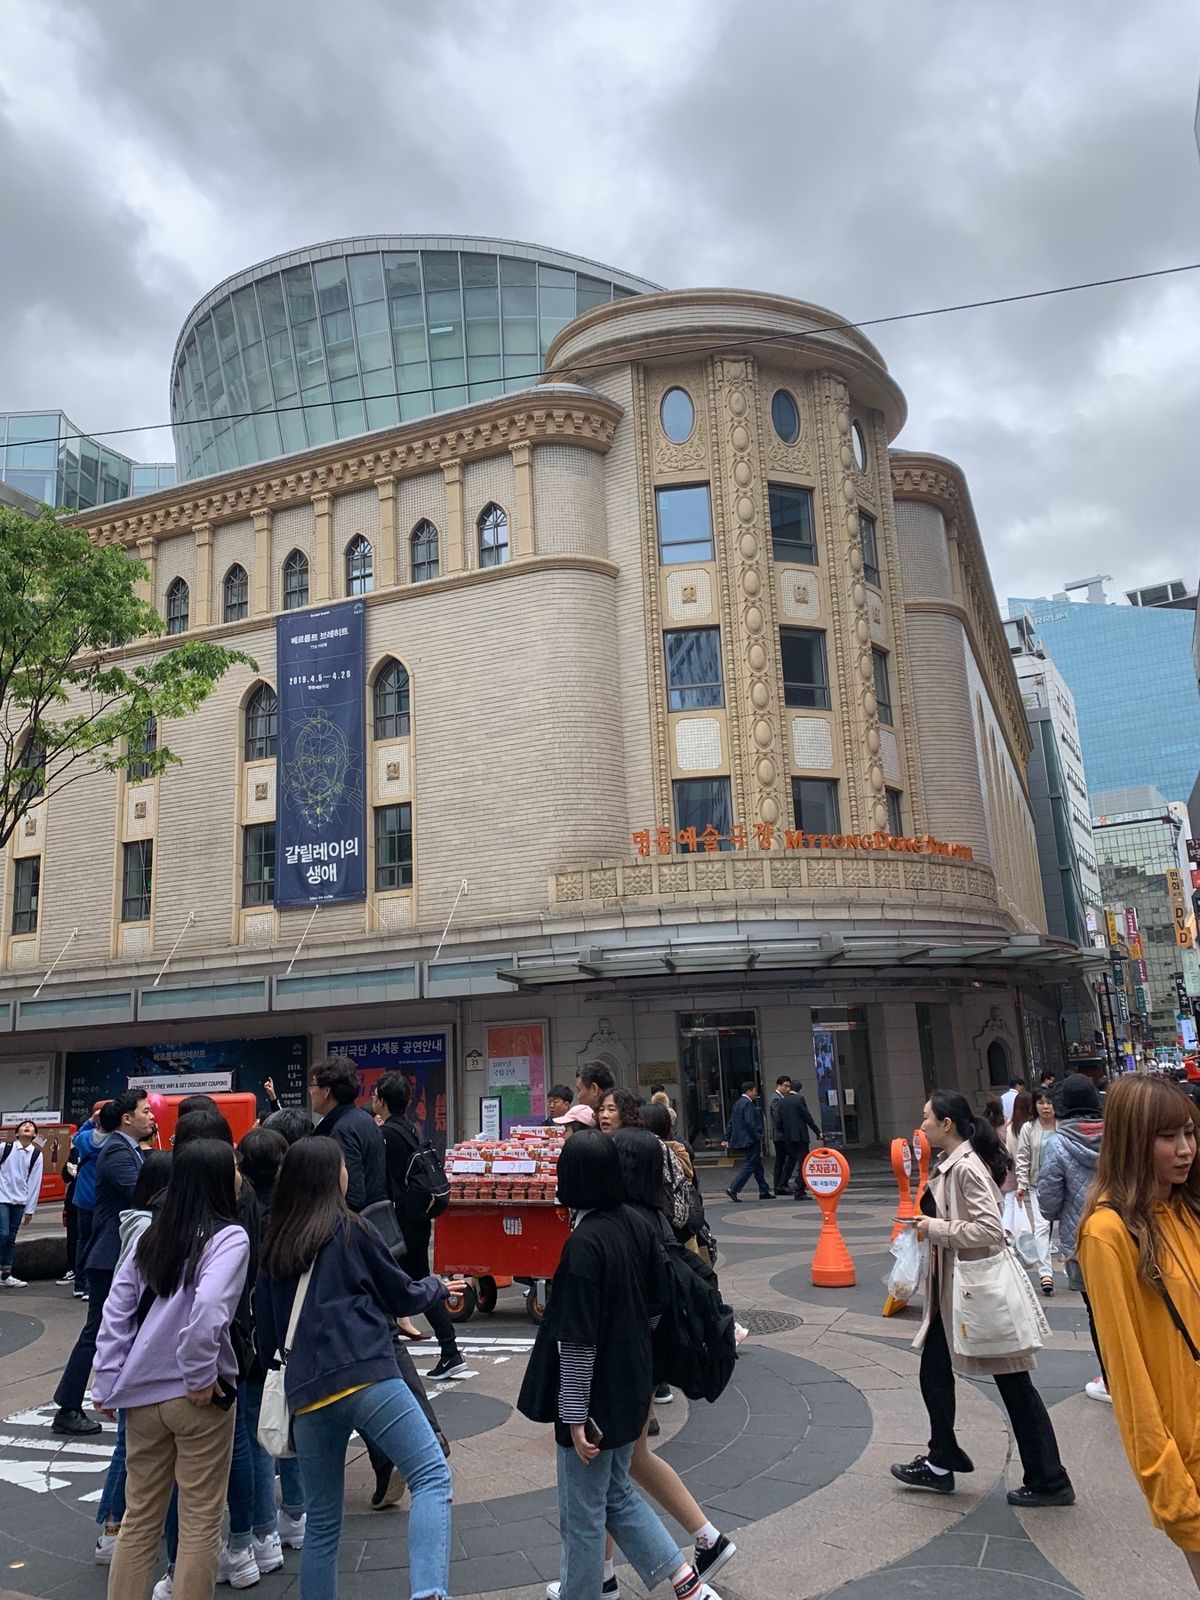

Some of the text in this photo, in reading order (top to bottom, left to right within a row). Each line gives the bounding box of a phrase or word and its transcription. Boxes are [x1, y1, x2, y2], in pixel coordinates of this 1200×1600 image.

[284, 836, 359, 865] 갈릴레이의
[631, 822, 773, 857] 명동예술극장
[306, 862, 338, 885] 생애
[1175, 907, 1188, 943] DVD
[371, 1041, 400, 1055] 서계동
[402, 1039, 443, 1054] 공연안내
[471, 1058, 479, 1066] 35
